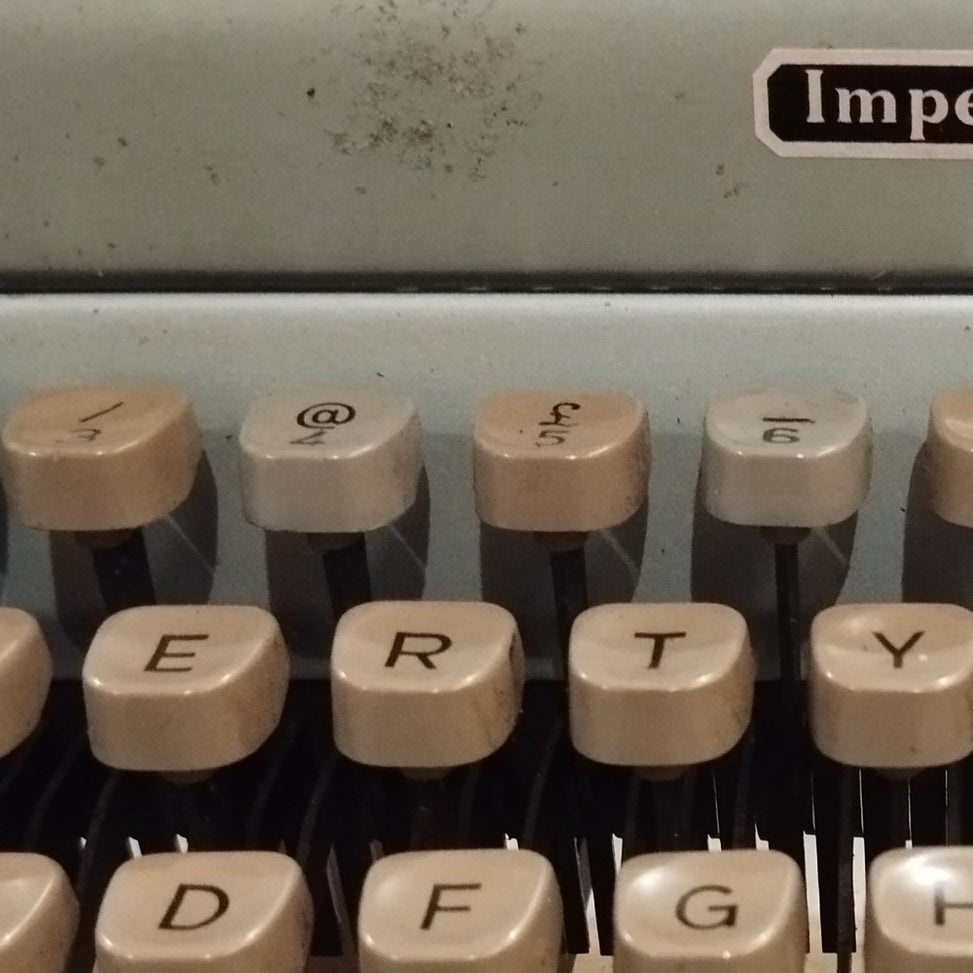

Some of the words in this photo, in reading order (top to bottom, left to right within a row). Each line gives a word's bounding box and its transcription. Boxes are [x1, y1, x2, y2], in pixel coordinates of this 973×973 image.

[296, 402, 356, 428] @
[539, 402, 581, 427] £
[289, 429, 327, 446] 4
[535, 430, 570, 447] 5
[762, 427, 800, 444] 6
[143, 633, 209, 673] E
[384, 631, 453, 669] R
[634, 631, 686, 669] T
[872, 630, 926, 669] Y
[158, 883, 230, 932] D
[419, 882, 482, 930] F
[675, 884, 737, 930] G
